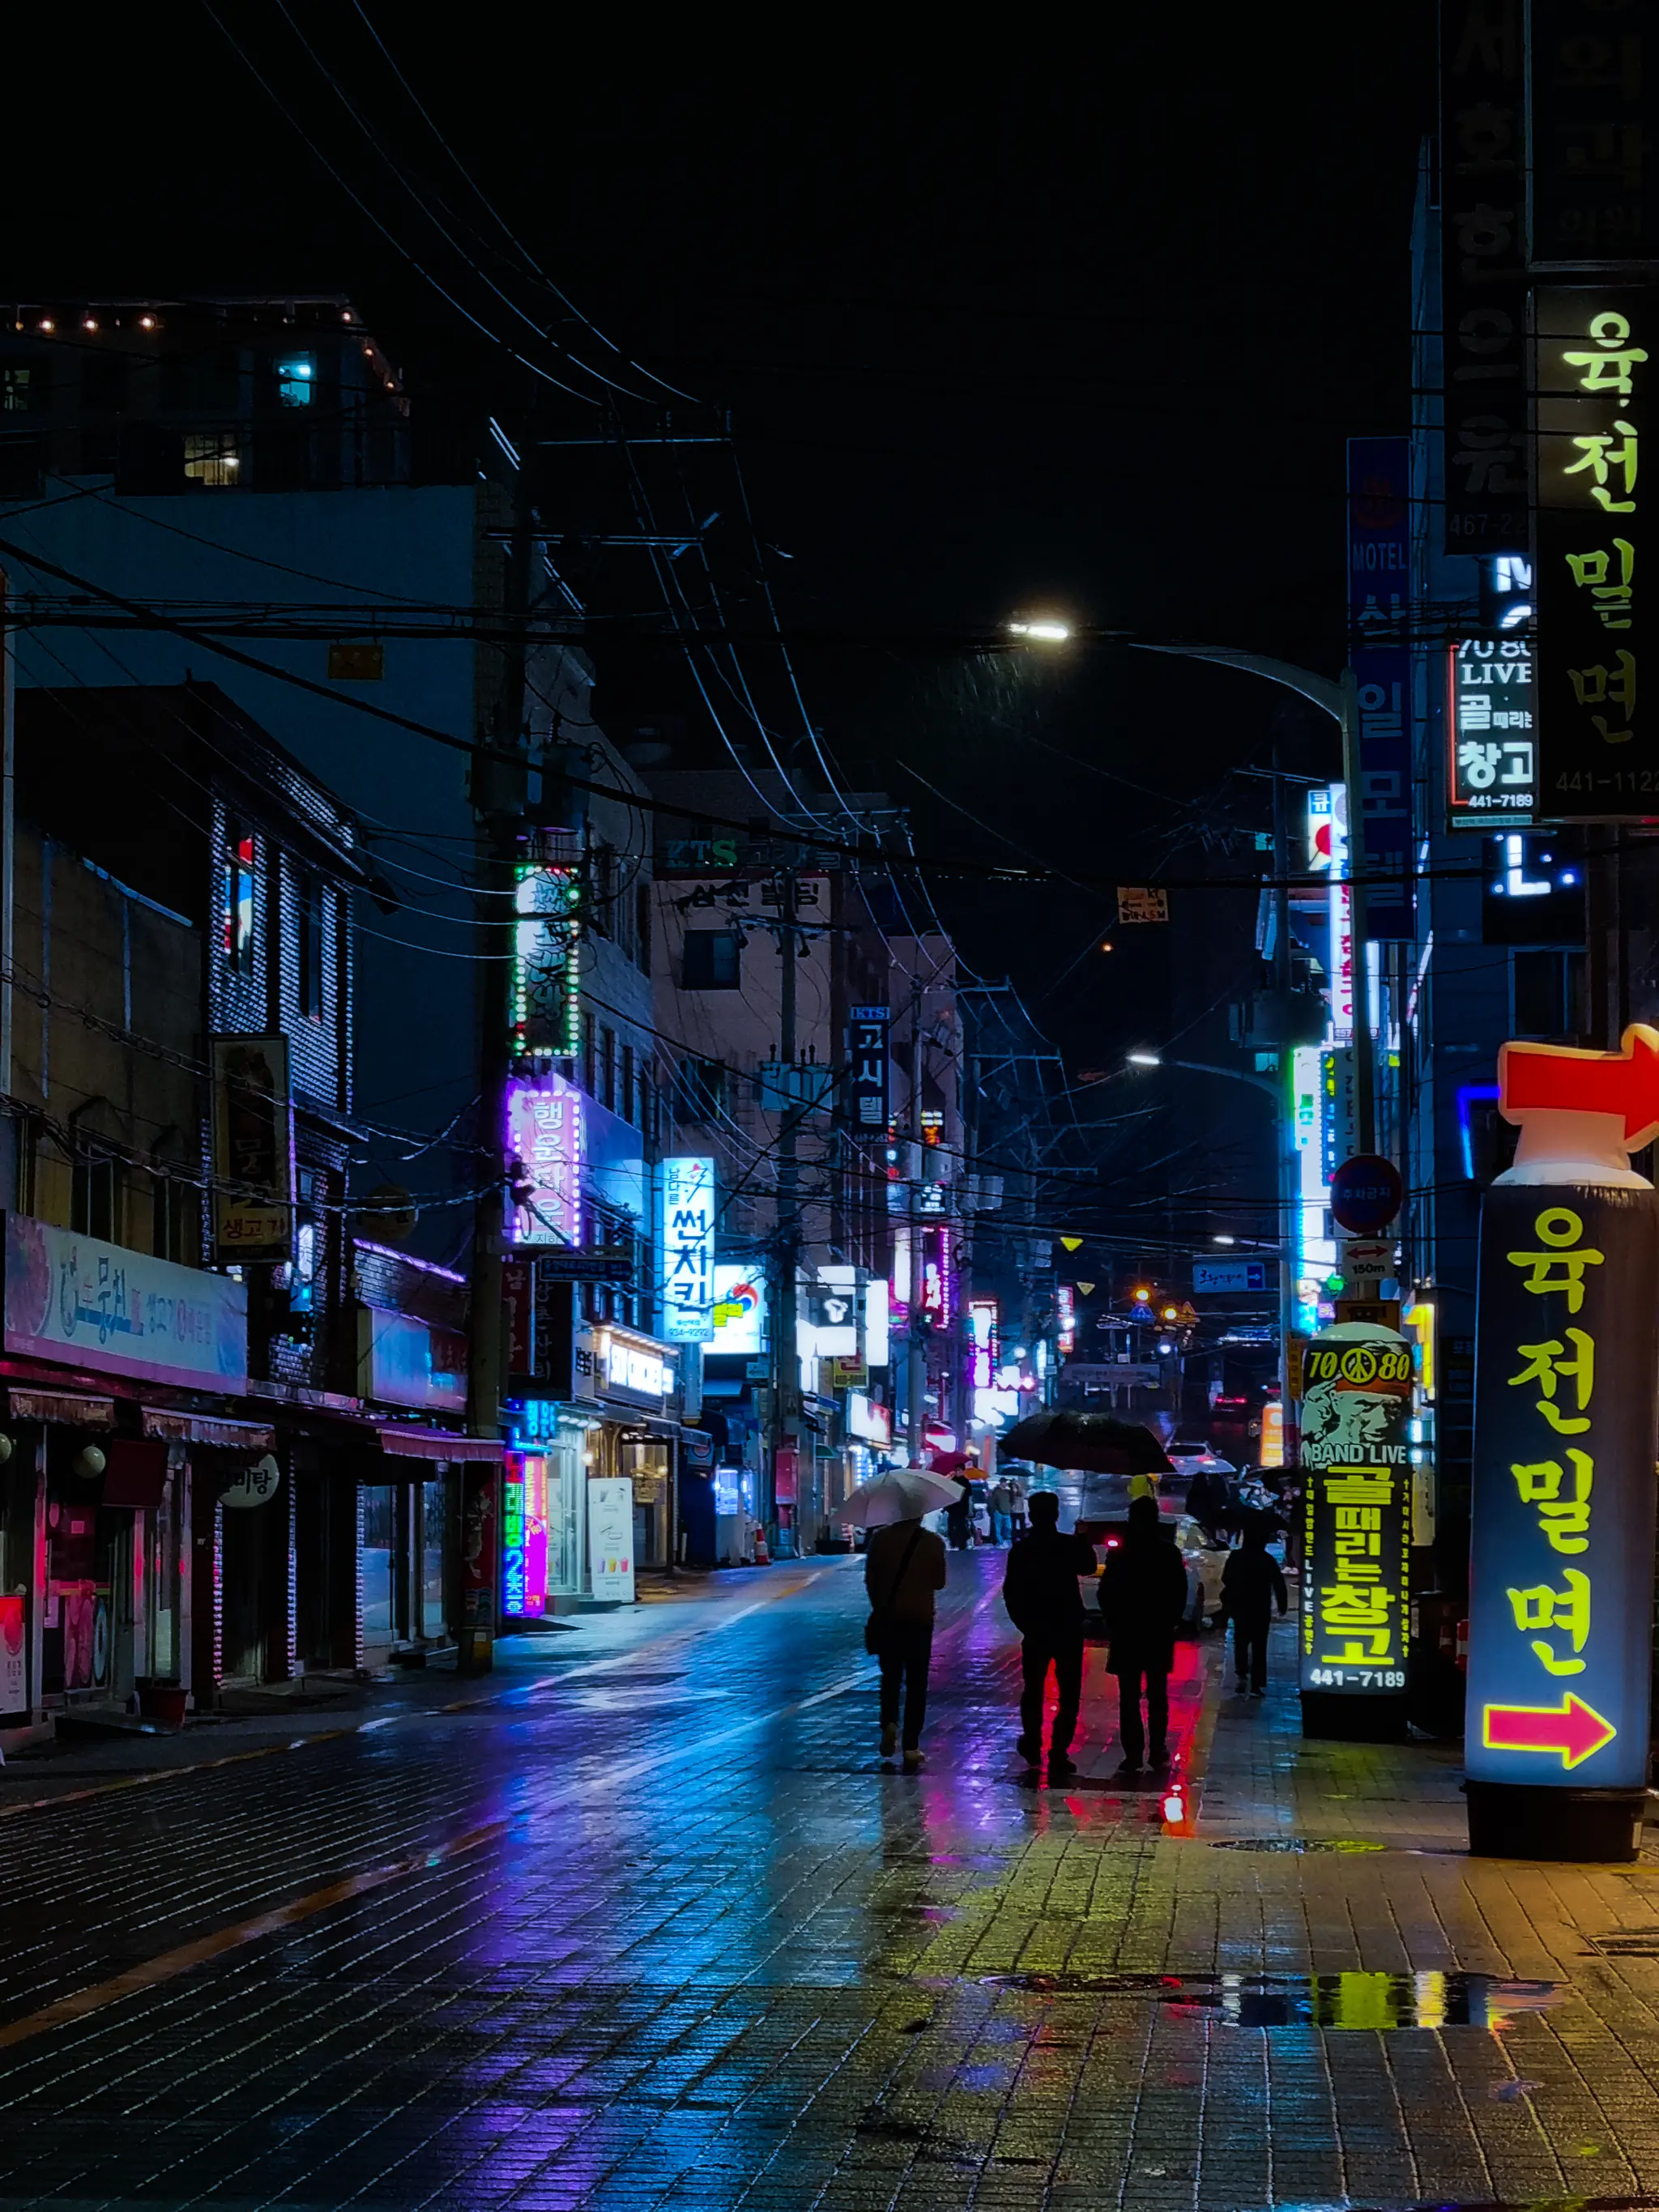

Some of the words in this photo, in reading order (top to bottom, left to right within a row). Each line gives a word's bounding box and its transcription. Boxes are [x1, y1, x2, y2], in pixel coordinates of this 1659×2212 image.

[1563, 310, 1650, 744] 육전밀면
[1354, 541, 1408, 573] MOTEL
[1461, 662, 1532, 685] LIVE
[1459, 741, 1533, 789] 창고
[1468, 792, 1533, 808] 441-7189
[855, 1006, 888, 1018] KTS
[858, 1024, 885, 1125] 고시텔
[672, 1209, 707, 1313] 썬치킨
[1353, 1264, 1385, 1275] 150m
[1309, 1352, 1337, 1378] 70
[1379, 1353, 1410, 1380] 80
[1311, 1443, 1363, 1463] BAND
[1371, 1445, 1406, 1464] LIVE
[1507, 1206, 1605, 1676] 육전밀면
[1310, 1669, 1405, 1688] 441-7189
